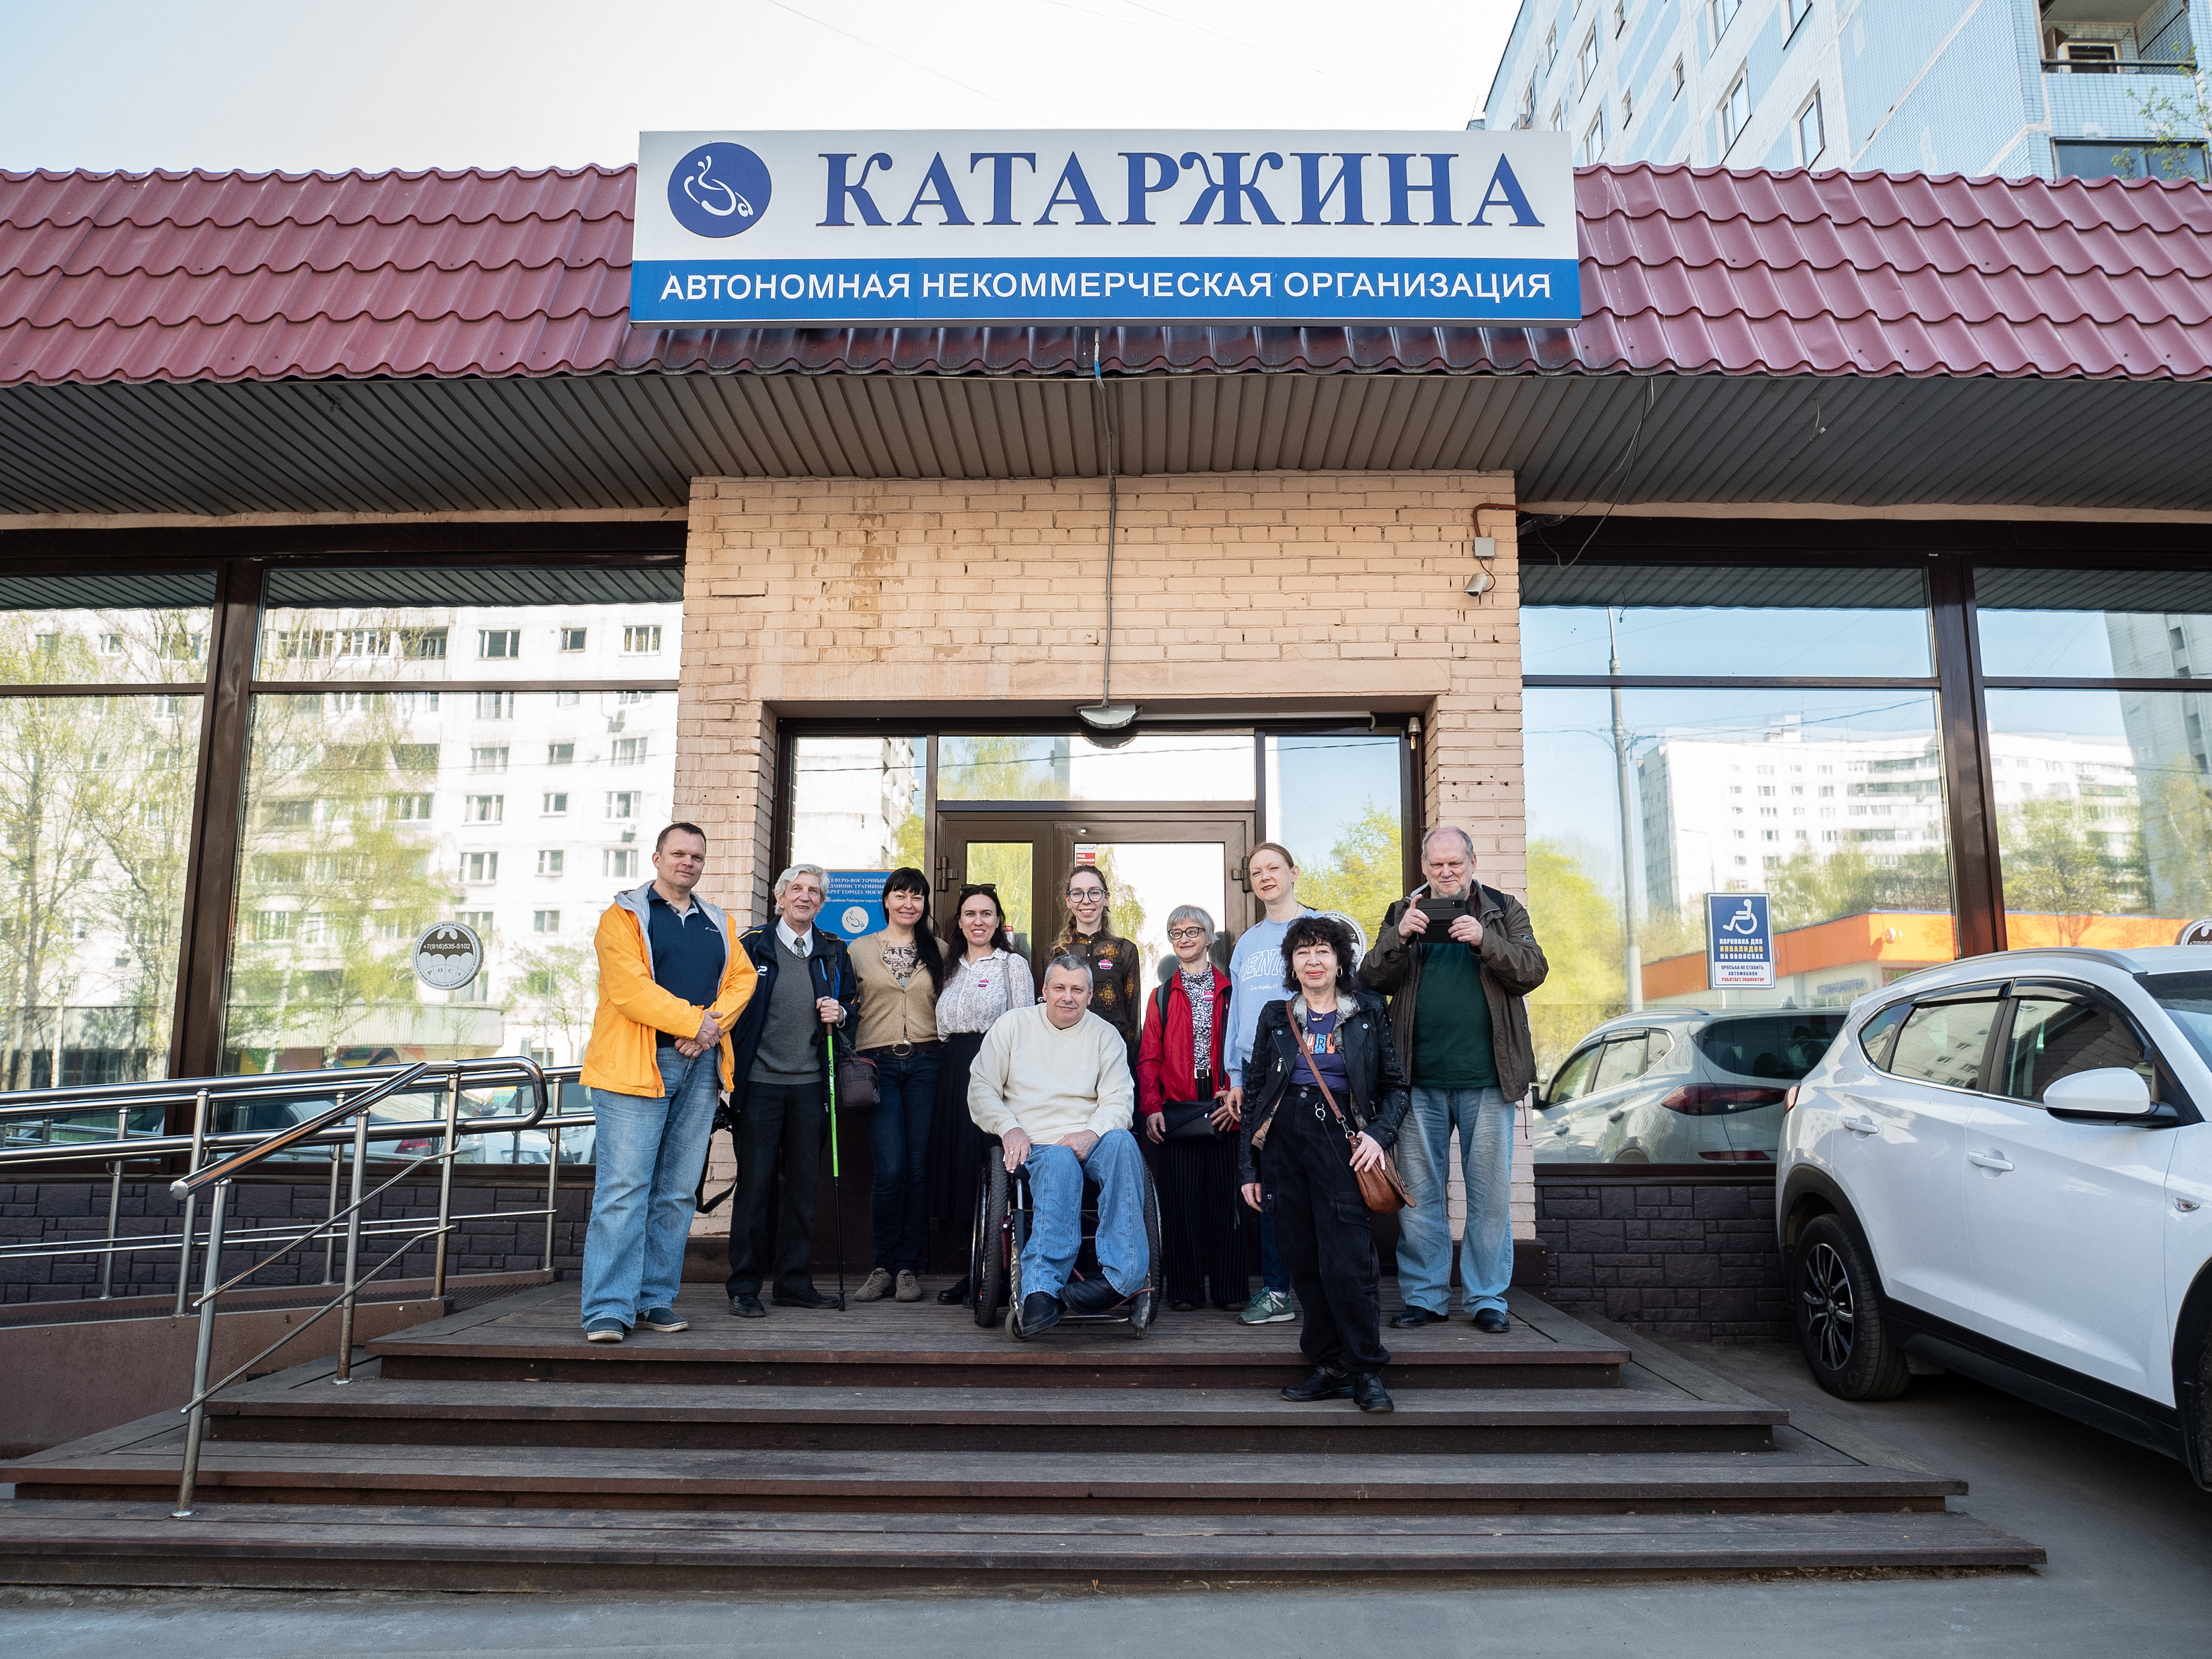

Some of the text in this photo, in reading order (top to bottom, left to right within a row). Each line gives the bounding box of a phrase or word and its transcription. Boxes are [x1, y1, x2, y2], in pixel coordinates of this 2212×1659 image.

[816, 150, 1545, 227] КАТАРЖИНА
[661, 272, 1552, 304] АВТОНОМНАЯ НЕКОММЕРЧЕСКАЯ ОРГАНИЗАЦИЯ
